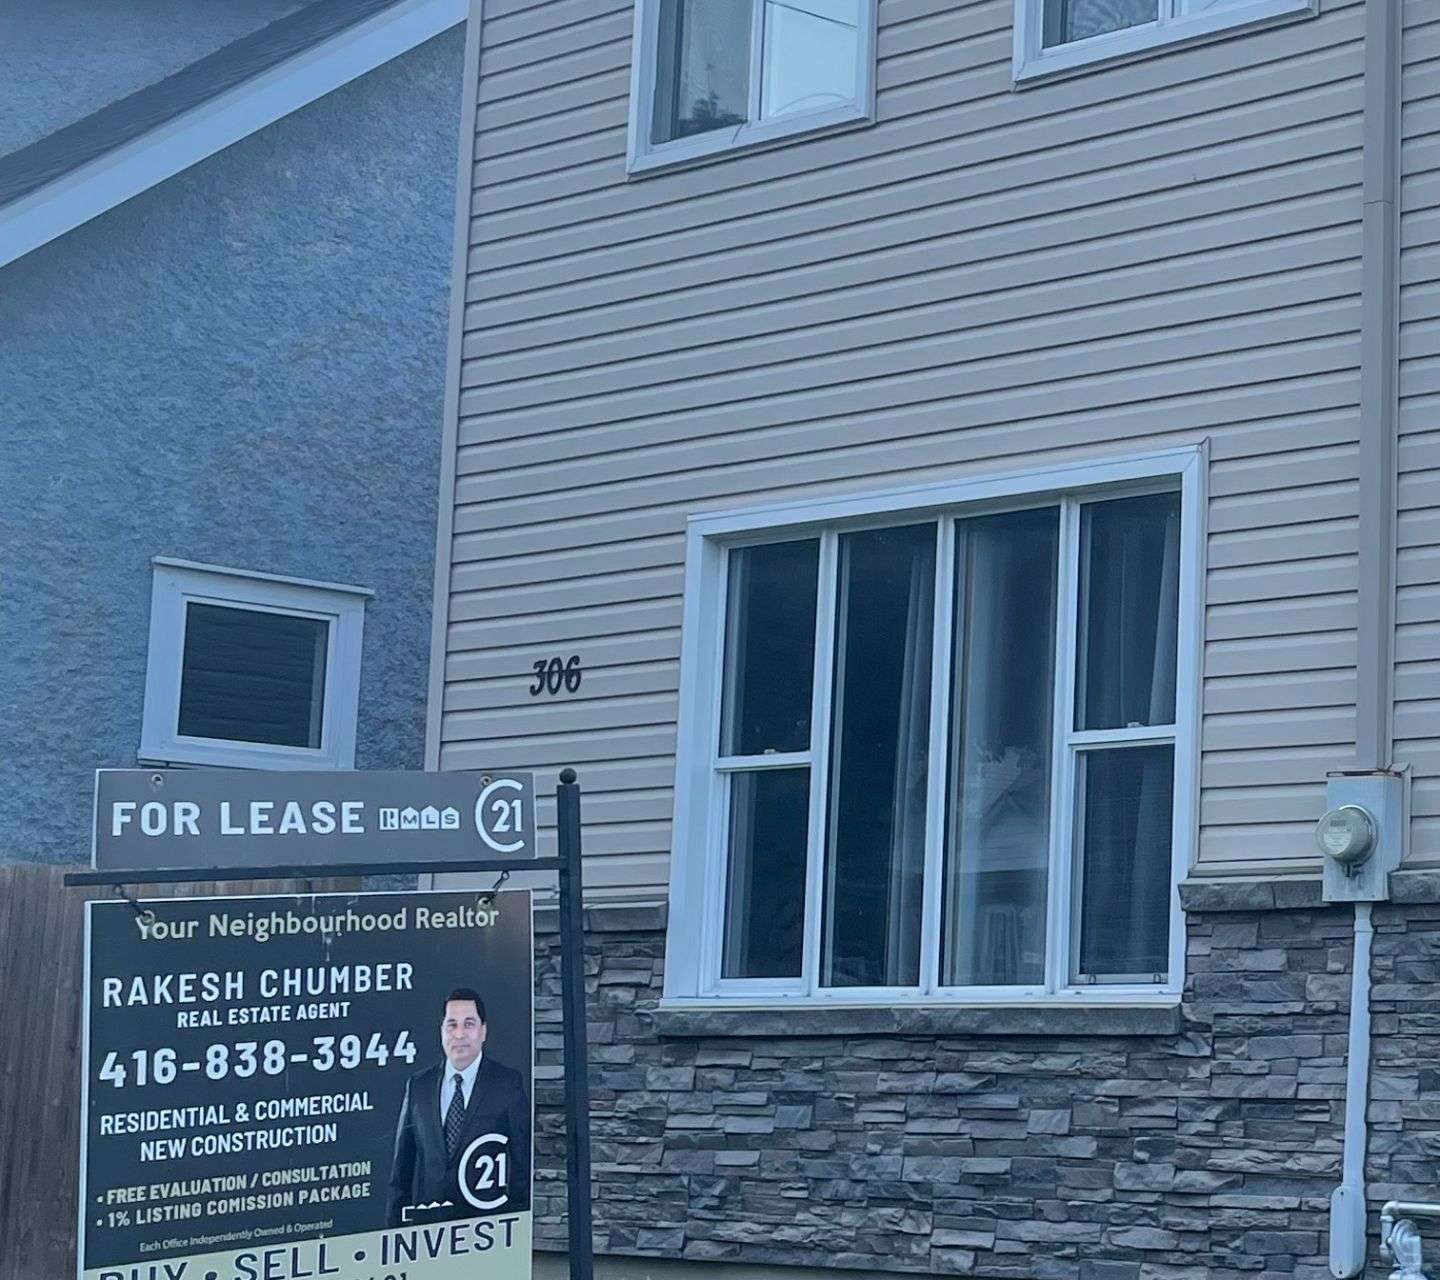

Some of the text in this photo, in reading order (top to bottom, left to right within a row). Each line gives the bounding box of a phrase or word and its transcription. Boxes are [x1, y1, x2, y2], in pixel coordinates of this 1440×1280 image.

[529, 655, 581, 696] 306
[112, 801, 365, 836] FOR LEASE
[135, 905, 500, 942] Your Neighbourhood Realtor
[103, 963, 413, 1007] RAKESH CHUMBER
[177, 1002, 351, 1028] REAL ESTATE AGENT
[99, 1030, 417, 1088] 416-838-3944
[100, 1091, 374, 1135] RESIDENTIAL & COMMERCIAL
[140, 1123, 338, 1162] NEW CONSTRUCTION
[106, 1160, 372, 1205] FREE EVALUATION / CONSULTATION
[108, 1182, 371, 1228] 1% LISTING COMISSION PACKAGE
[139, 1242, 161, 1252] Each
[381, 1217, 520, 1266] INVEST
